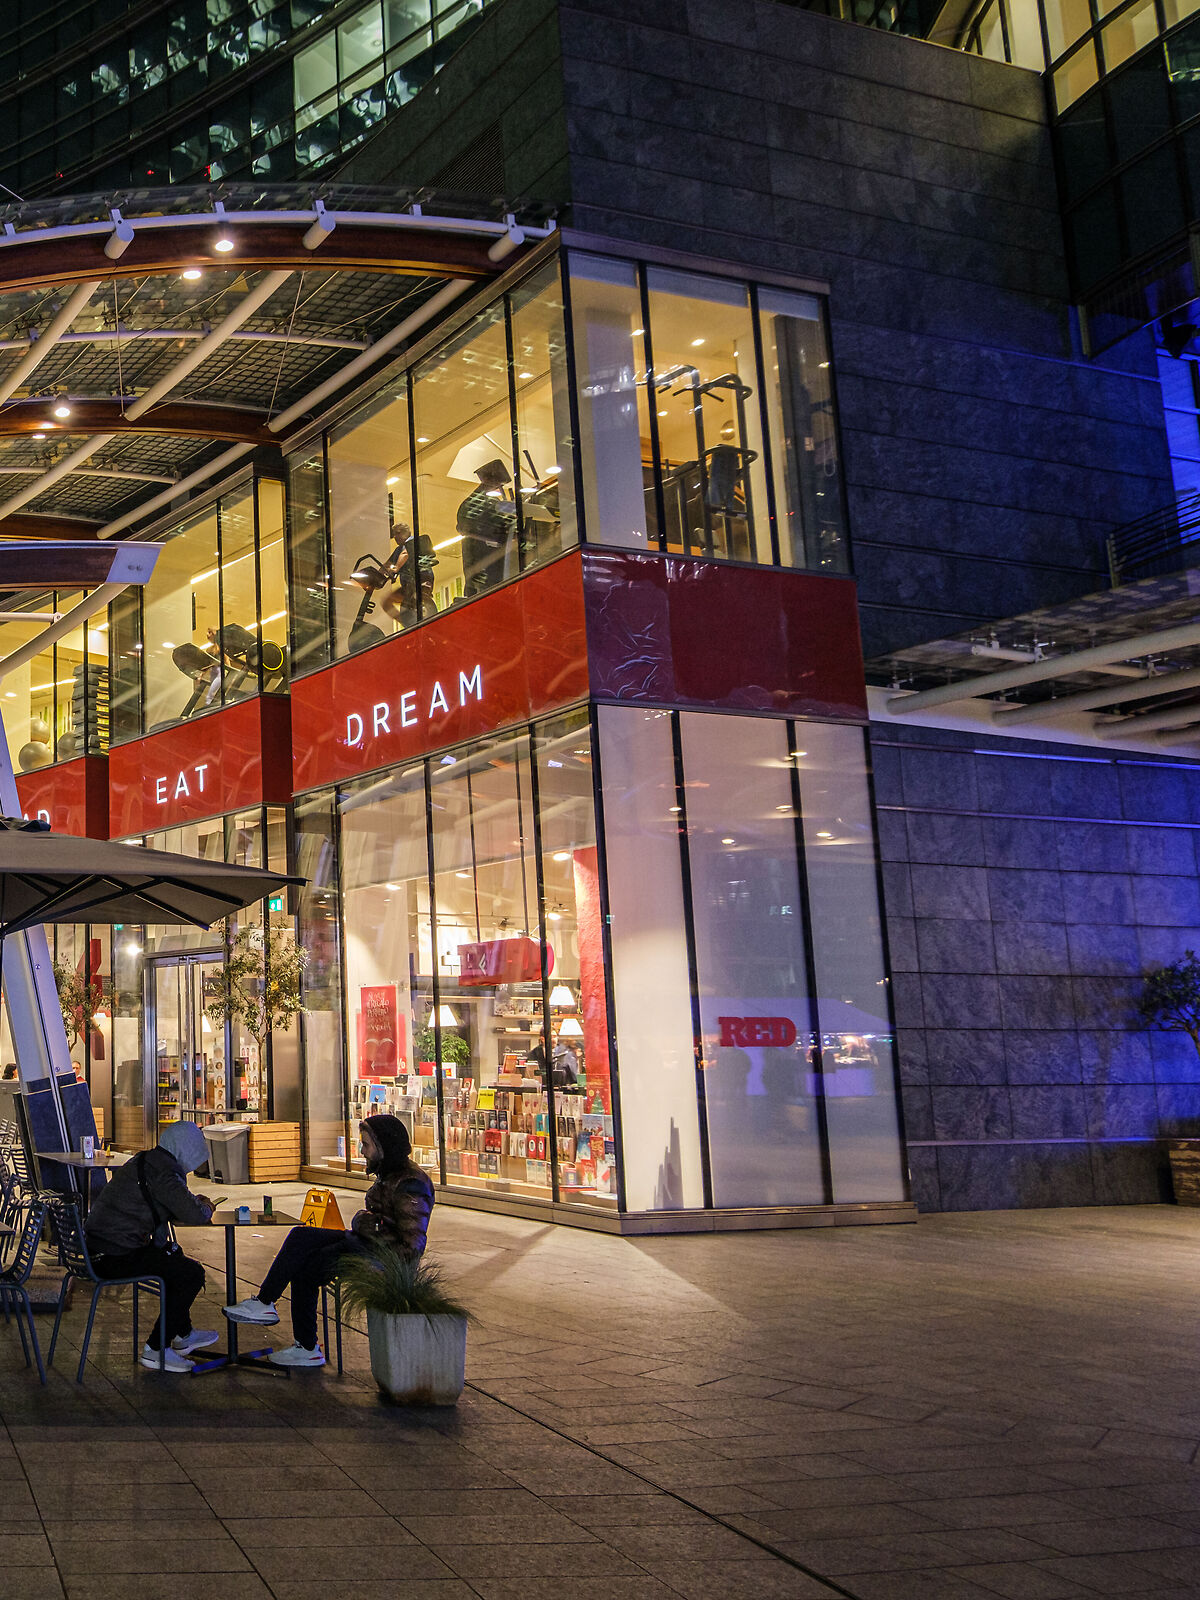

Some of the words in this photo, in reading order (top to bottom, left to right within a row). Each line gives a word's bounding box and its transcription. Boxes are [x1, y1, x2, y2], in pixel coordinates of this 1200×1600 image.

[346, 665, 484, 746] DREAM
[156, 765, 208, 804] EAT
[718, 1016, 797, 1048] RED
